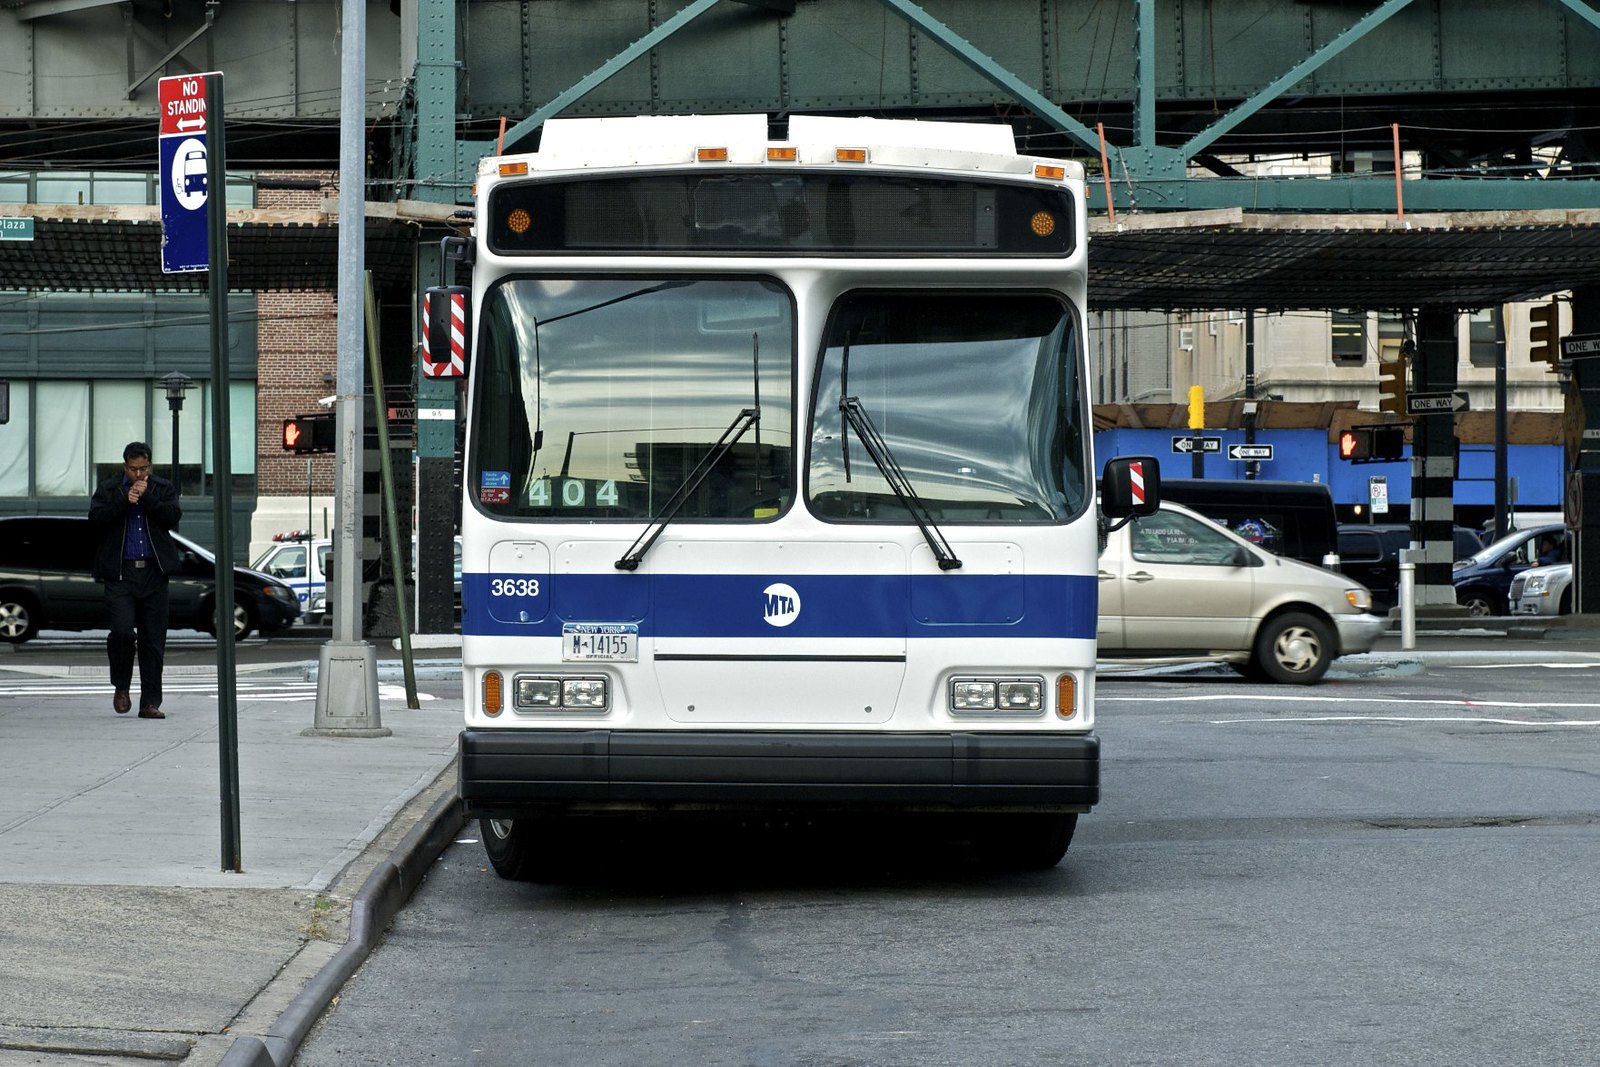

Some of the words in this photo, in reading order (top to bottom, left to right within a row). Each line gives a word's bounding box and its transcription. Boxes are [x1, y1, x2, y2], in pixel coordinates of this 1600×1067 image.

[183, 81, 198, 97] NO
[167, 98, 207, 116] STANDIN
[1569, 342, 1588, 352] ONE
[1414, 400, 1431, 408] ONE
[1436, 399, 1452, 407] WAY
[396, 408, 415, 419] WAY
[491, 579, 540, 596] 3638
[763, 592, 794, 617] MTA
[581, 625, 598, 634] NEW
[600, 625, 620, 634] YORK
